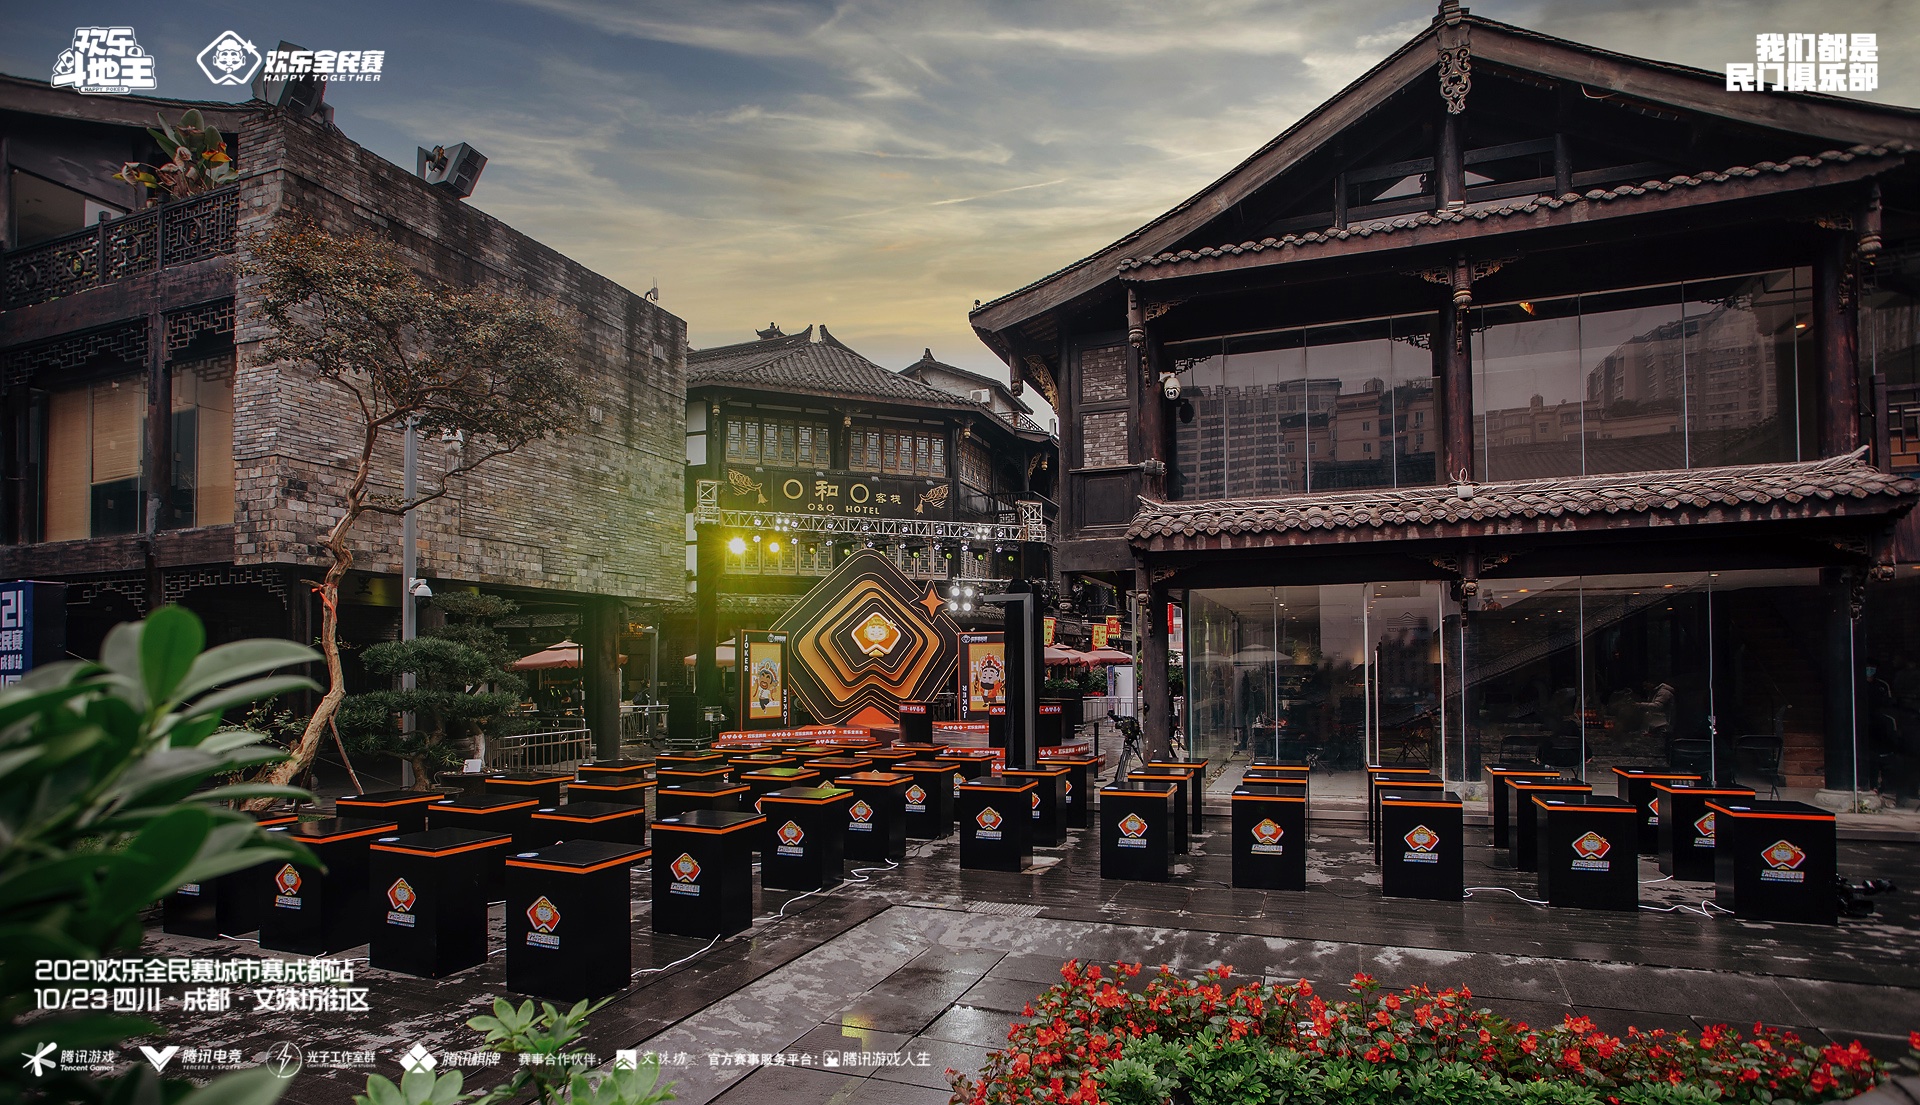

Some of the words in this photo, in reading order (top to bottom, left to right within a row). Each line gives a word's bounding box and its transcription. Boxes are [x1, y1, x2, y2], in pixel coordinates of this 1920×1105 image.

[808, 503, 834, 512] O&O
[845, 505, 880, 515] HOTEL
[0, 630, 23, 651] 民赛
